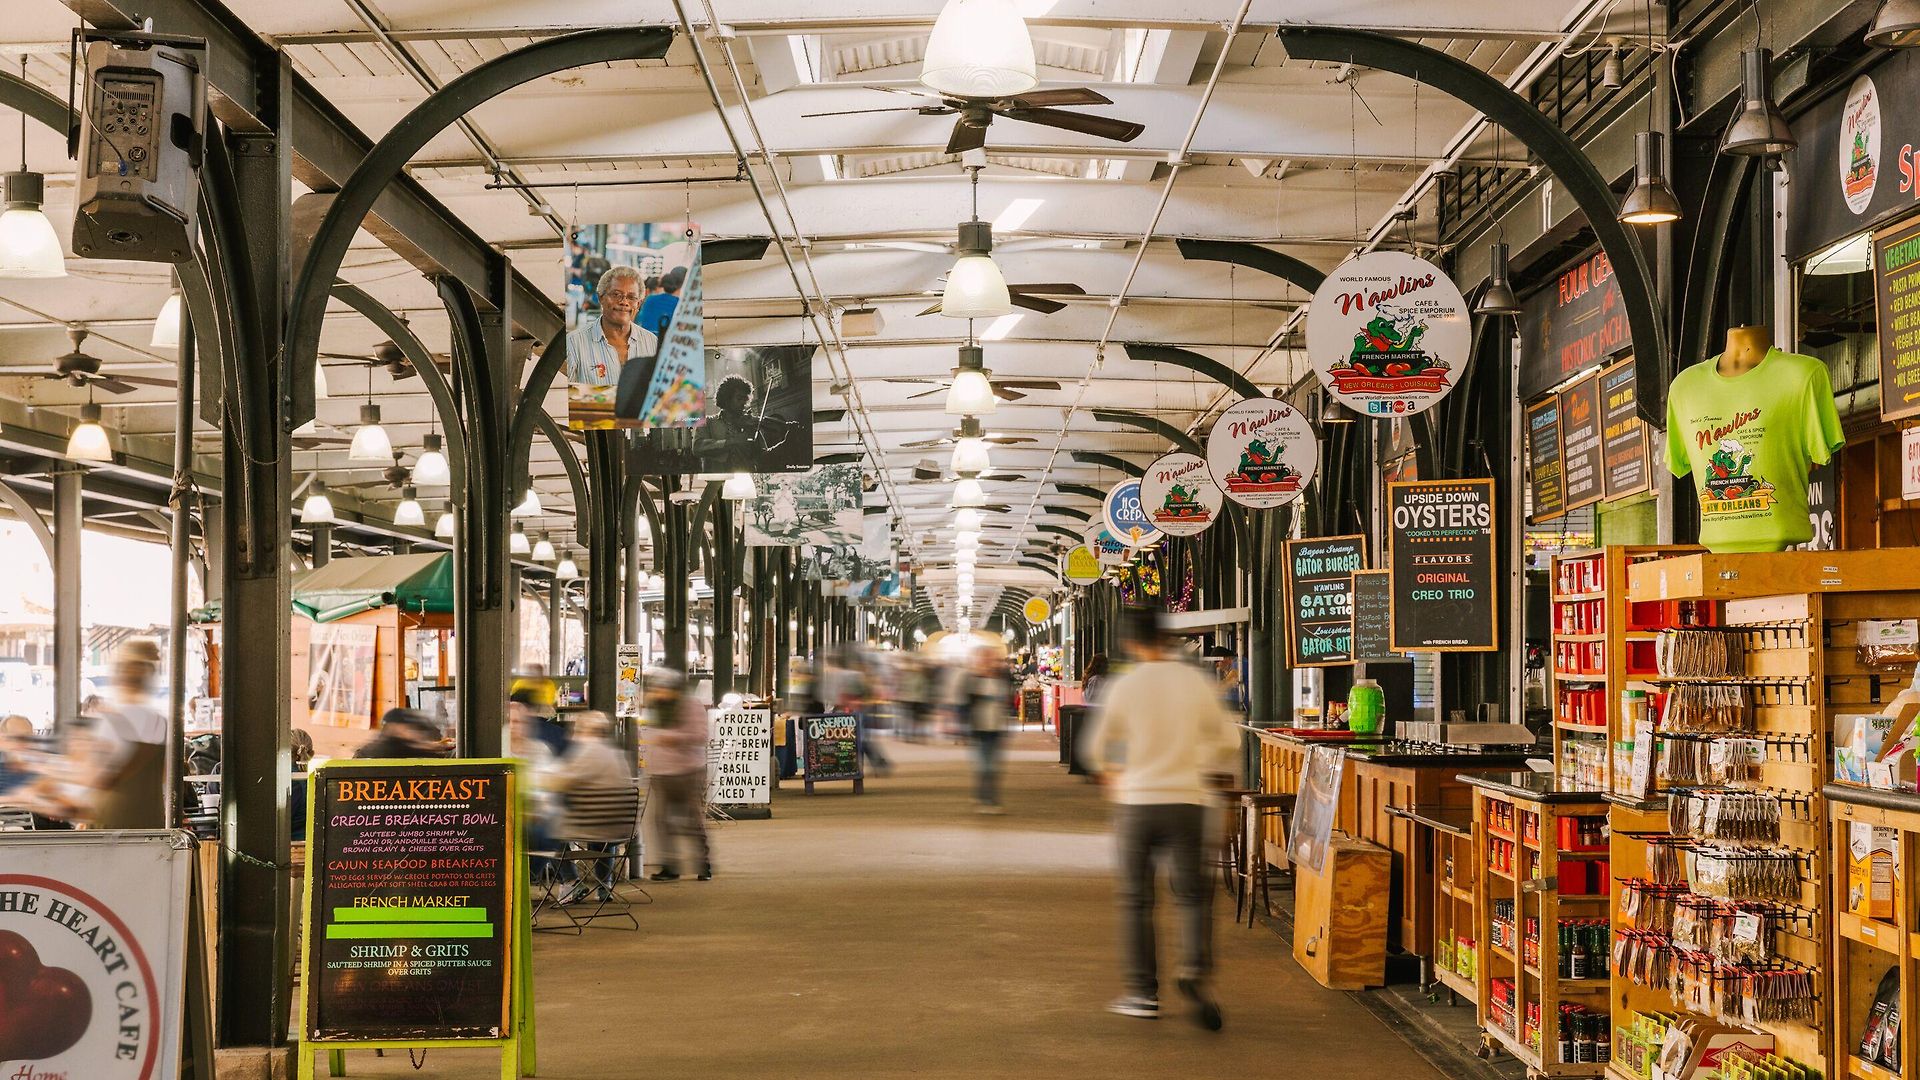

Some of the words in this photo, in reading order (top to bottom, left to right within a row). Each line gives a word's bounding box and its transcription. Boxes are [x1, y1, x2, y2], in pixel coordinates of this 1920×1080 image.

[1559, 262, 1589, 308] FOUR
[1561, 332, 1597, 373] HISTORIC
[1361, 381, 1394, 389] ORLEANS
[1404, 493, 1443, 505] UPSIDE
[1446, 492, 1479, 503] DOWN
[1707, 502, 1719, 512] NEW
[1722, 499, 1760, 511] ORLEANS
[1393, 503, 1490, 530] OYSTERS
[1296, 557, 1323, 577] GATOR
[1326, 553, 1360, 573] BURGER
[1415, 555, 1471, 563] FLAVORS
[1417, 573, 1470, 584] ORIGINAL
[1314, 583, 1345, 592] N'AWLINS
[1412, 590, 1444, 601] CREO
[1448, 589, 1474, 600] TRIO
[1300, 607, 1315, 618] ON
[1318, 607, 1326, 616] A
[1302, 637, 1332, 656] GATOR
[724, 714, 763, 724] FROZEN
[720, 726, 732, 736] OR
[737, 726, 759, 736] ICED
[825, 727, 856, 739] DOCK
[723, 764, 750, 773] BASIL
[711, 776, 766, 786] EMONADE
[337, 779, 490, 802] BREAKFAST
[722, 789, 744, 798] ICED
[751, 789, 756, 798] T
[330, 815, 381, 827] CREOLE
[384, 814, 459, 826] BREAKFAST
[462, 813, 498, 825] BOWL
[328, 860, 368, 870] CAJUN
[372, 859, 428, 869] SEAFOOD
[431, 858, 498, 869] BREAKFAST
[354, 896, 408, 908] FRENCH
[412, 896, 470, 908] MARKET
[350, 945, 408, 958] SHRIMP
[410, 945, 422, 957] &
[425, 944, 469, 957] GRITS
[409, 960, 436, 968] SPICED
[388, 968, 409, 976] OVER
[409, 968, 432, 976] GRITS
[44, 898, 129, 975] HEART
[115, 981, 141, 1060] CAFE
